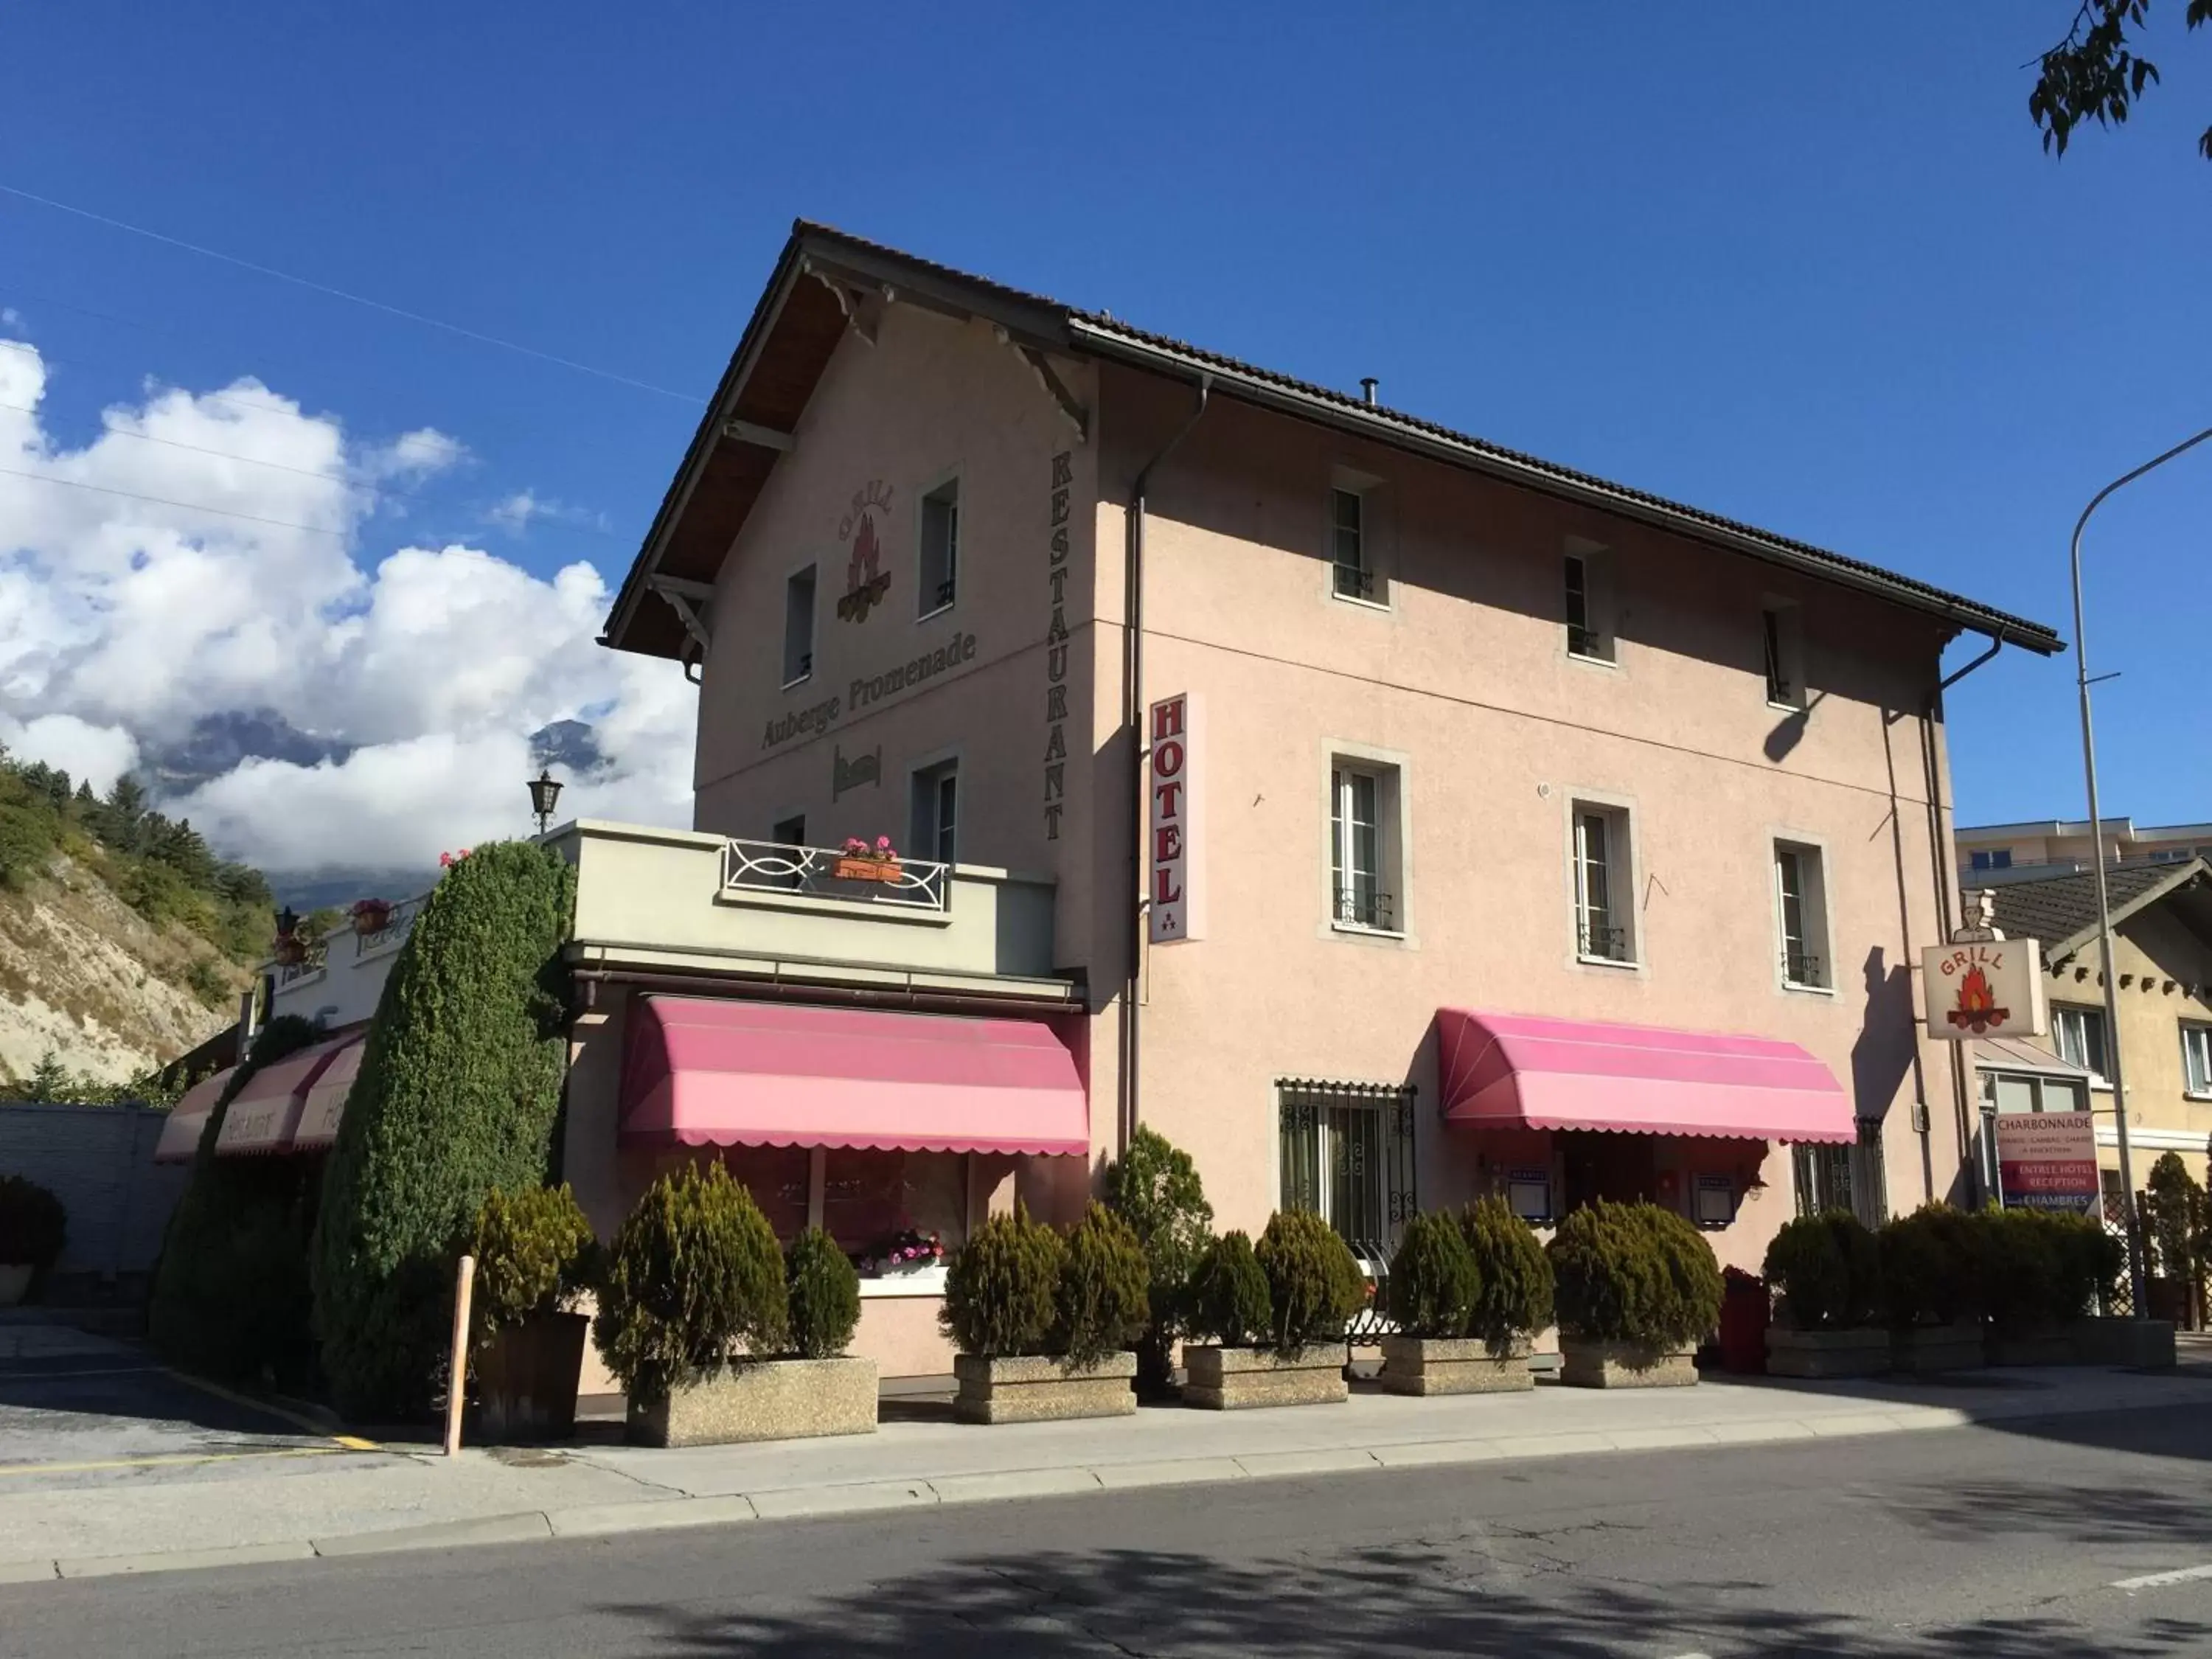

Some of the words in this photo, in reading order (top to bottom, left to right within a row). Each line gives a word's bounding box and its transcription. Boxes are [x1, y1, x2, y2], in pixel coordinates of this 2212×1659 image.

[838, 480, 894, 541] GRILL
[1044, 451, 1073, 841] RESTAURANT
[762, 696, 840, 749] Auberge
[849, 632, 976, 711] Promenade
[1154, 699, 1184, 906] HOTEL
[1940, 946, 2003, 977] GRILL
[1997, 1117, 2092, 1130] CHARBONNADE
[2023, 1194, 2088, 1206] CHAMBRES
